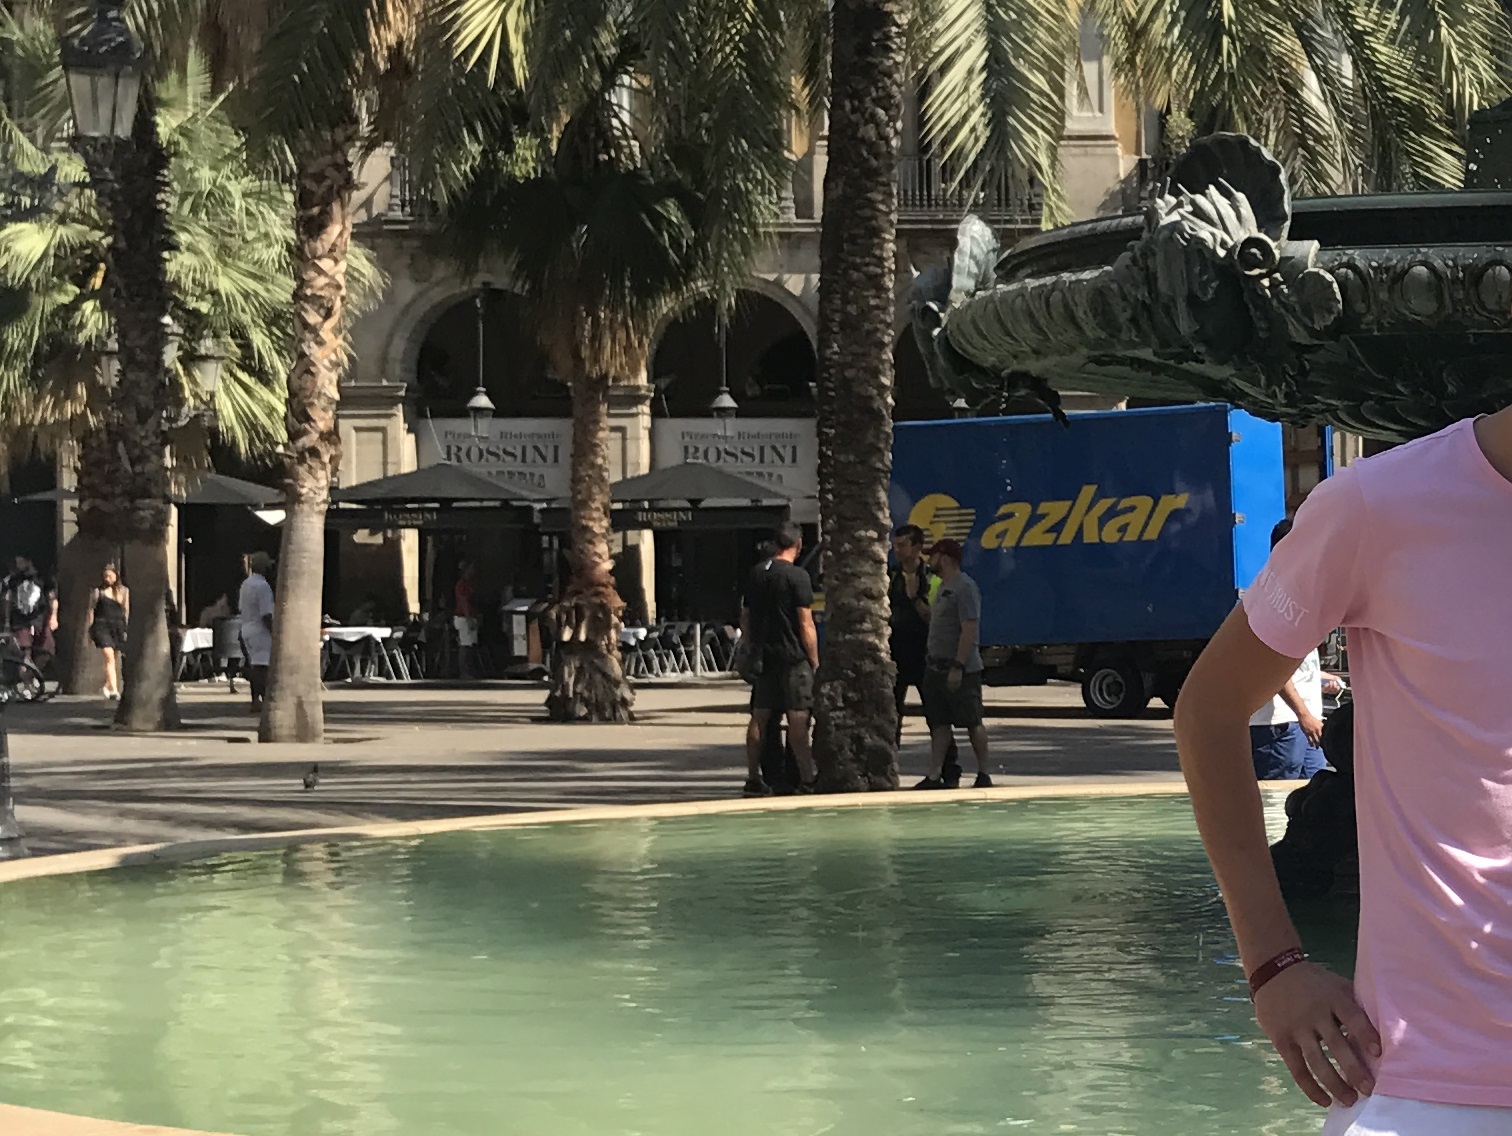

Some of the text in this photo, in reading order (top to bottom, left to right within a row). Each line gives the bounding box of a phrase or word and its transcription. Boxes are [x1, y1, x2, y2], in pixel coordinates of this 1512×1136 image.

[446, 444, 559, 463] ROSSINI
[682, 444, 798, 464] ROSSINI
[980, 484, 1190, 550] azkar
